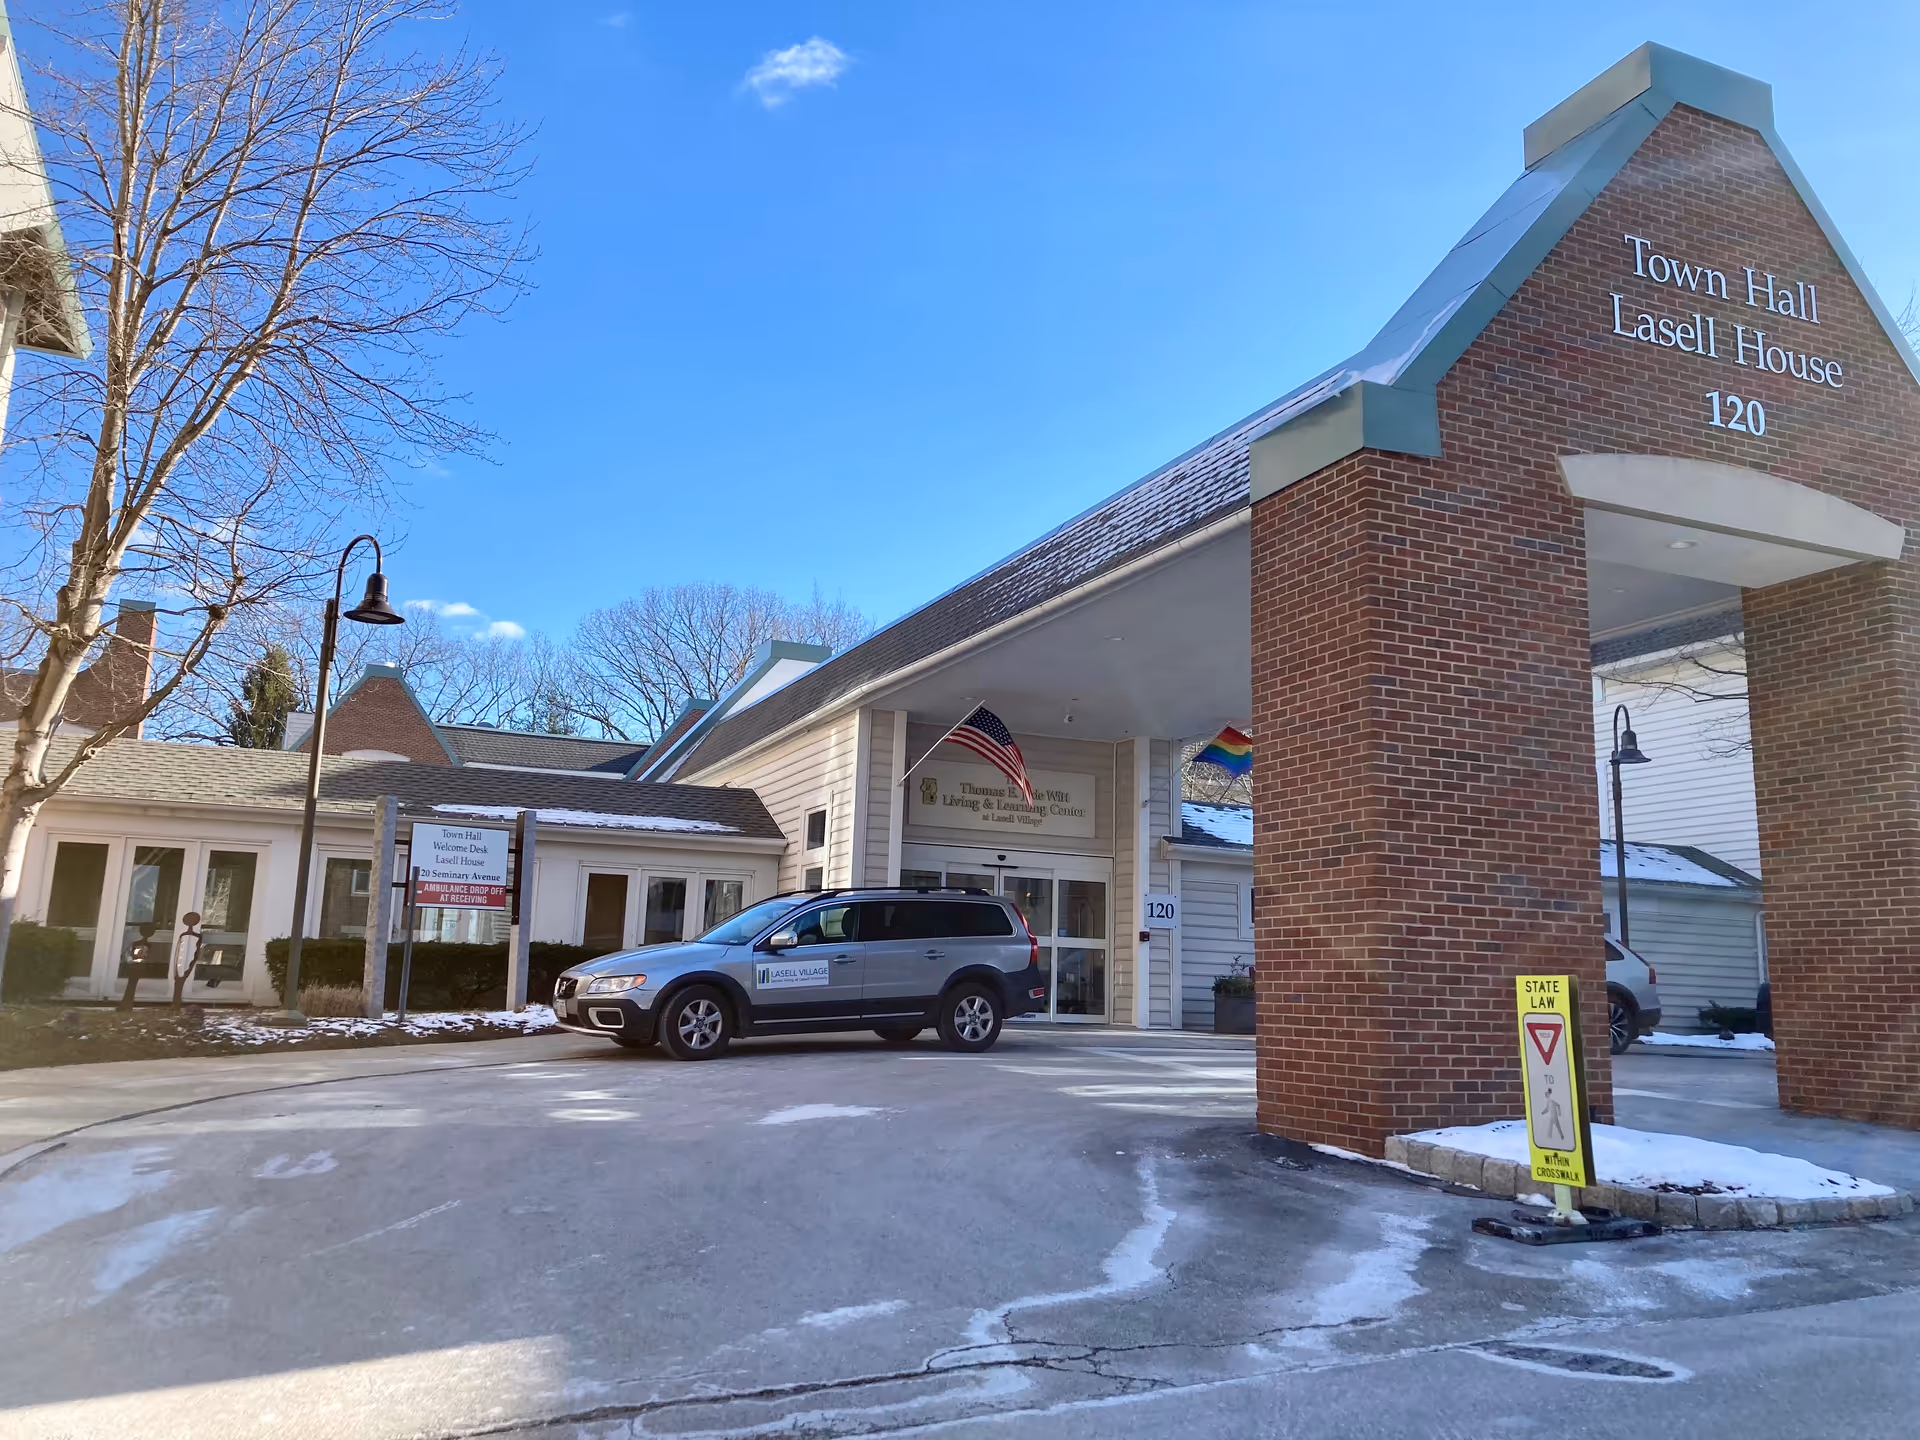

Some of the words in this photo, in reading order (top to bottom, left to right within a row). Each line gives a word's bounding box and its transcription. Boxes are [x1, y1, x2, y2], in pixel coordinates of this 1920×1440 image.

[1623, 233, 1730, 301] Town
[1742, 266, 1821, 325] Hall
[1608, 292, 1719, 359] Lasell
[1733, 323, 1844, 389] House
[1704, 390, 1767, 437] 120
[959, 782, 1005, 798] Thomas
[942, 794, 981, 812] Living
[982, 798, 994, 810] &
[1049, 804, 1086, 817] Center
[981, 814, 990, 822] at
[991, 813, 1015, 824] Lasell
[1016, 815, 1043, 827] Village
[441, 829, 463, 840] Town
[465, 831, 482, 841] Hall
[433, 841, 468, 853] Welcome
[469, 844, 489, 854] Desk
[435, 855, 458, 865] Lasell
[460, 856, 485, 867] House
[432, 869, 470, 882] Seminary
[471, 872, 501, 882] Avenue
[424, 883, 469, 894] AMBULANCE
[470, 886, 489, 895] DROP
[490, 887, 504, 896] OFF
[439, 894, 449, 902] AT
[450, 895, 488, 904] RECEIVING
[1147, 901, 1175, 919] 120
[771, 969, 797, 978] LASELL
[799, 968, 828, 976] VILLAGE
[1525, 980, 1560, 993] STATE
[1530, 996, 1555, 1009] LAW
[1543, 1074, 1555, 1085] TO
[1544, 1155, 1570, 1167] WITHIN
[1536, 1166, 1581, 1183] CROSSWALK
